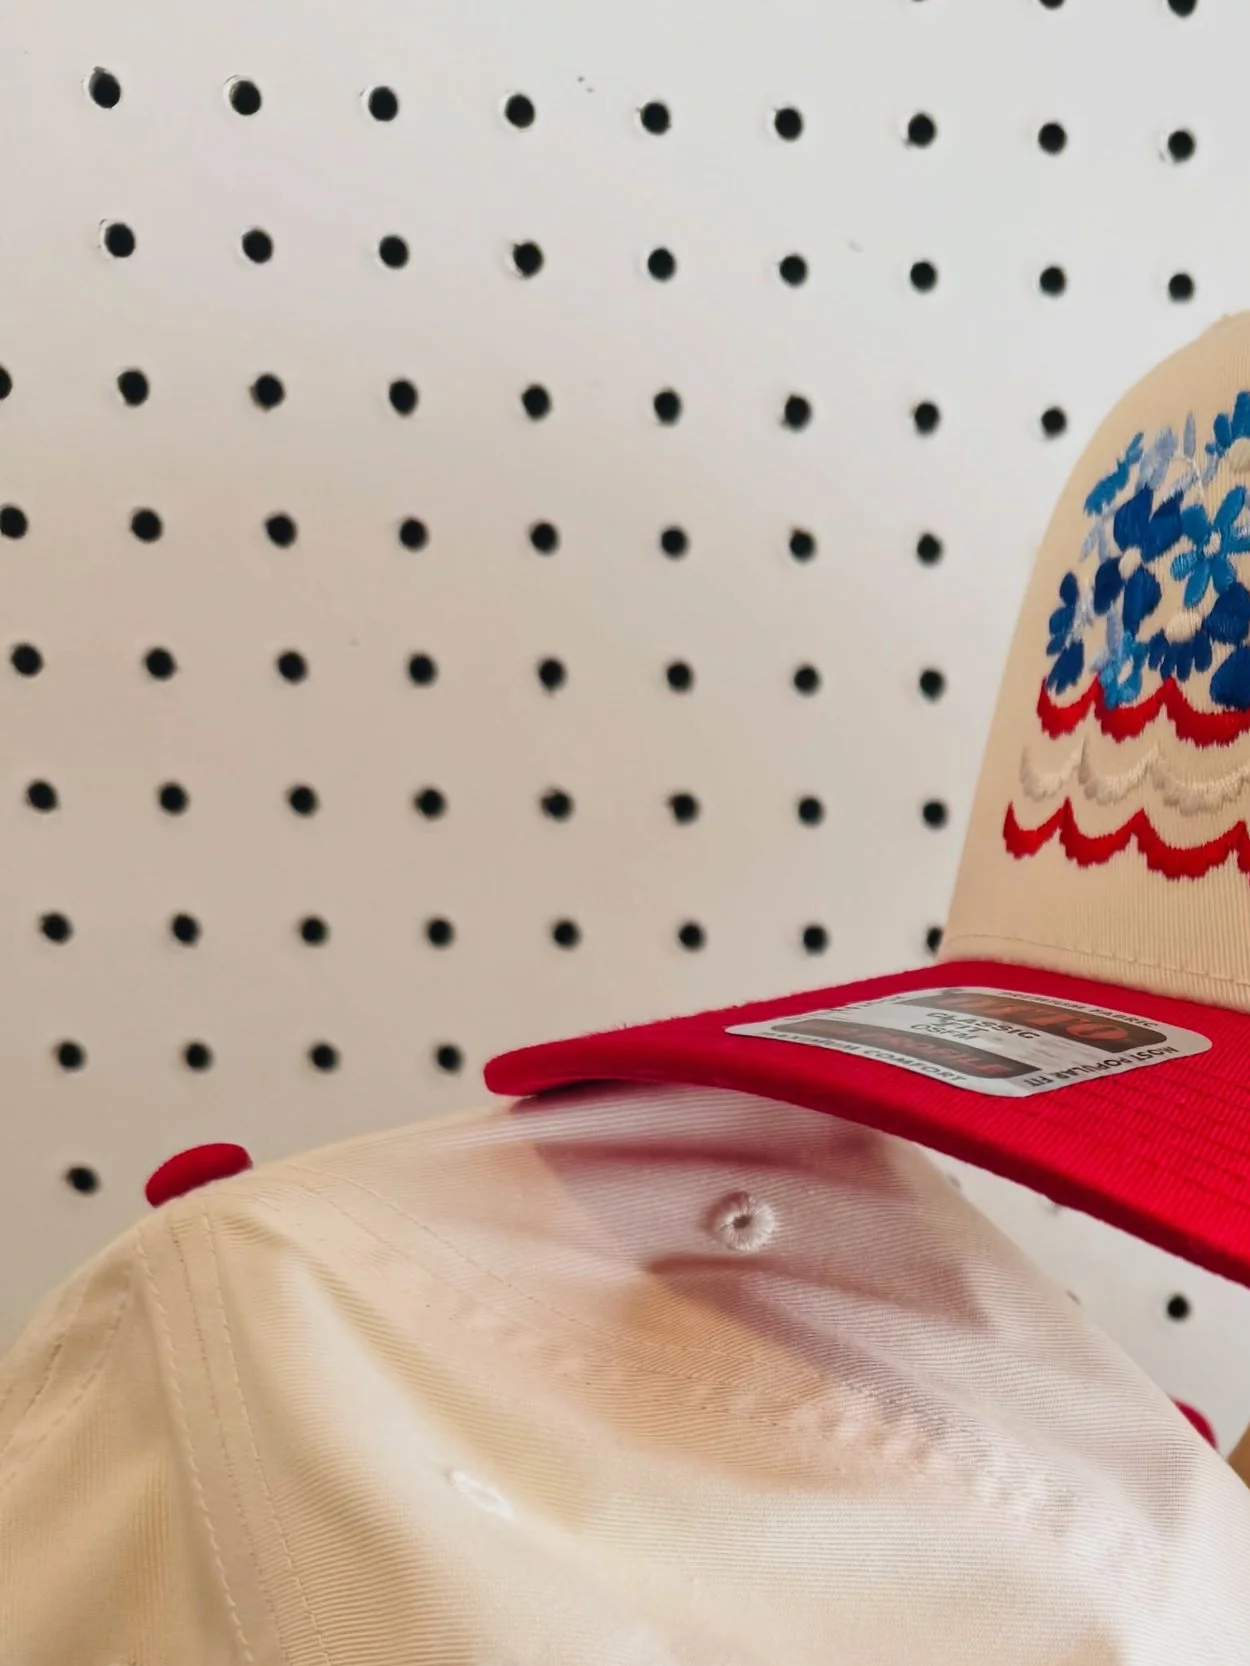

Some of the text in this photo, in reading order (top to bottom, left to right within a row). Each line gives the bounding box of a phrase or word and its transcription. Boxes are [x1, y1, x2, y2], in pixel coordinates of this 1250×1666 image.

[911, 1023, 981, 1041] OSFM
[925, 1012, 1041, 1040] CLASSIC
[863, 1048, 968, 1083] COMFORT
[1023, 1046, 1179, 1088] MOST POPULAR FIT
